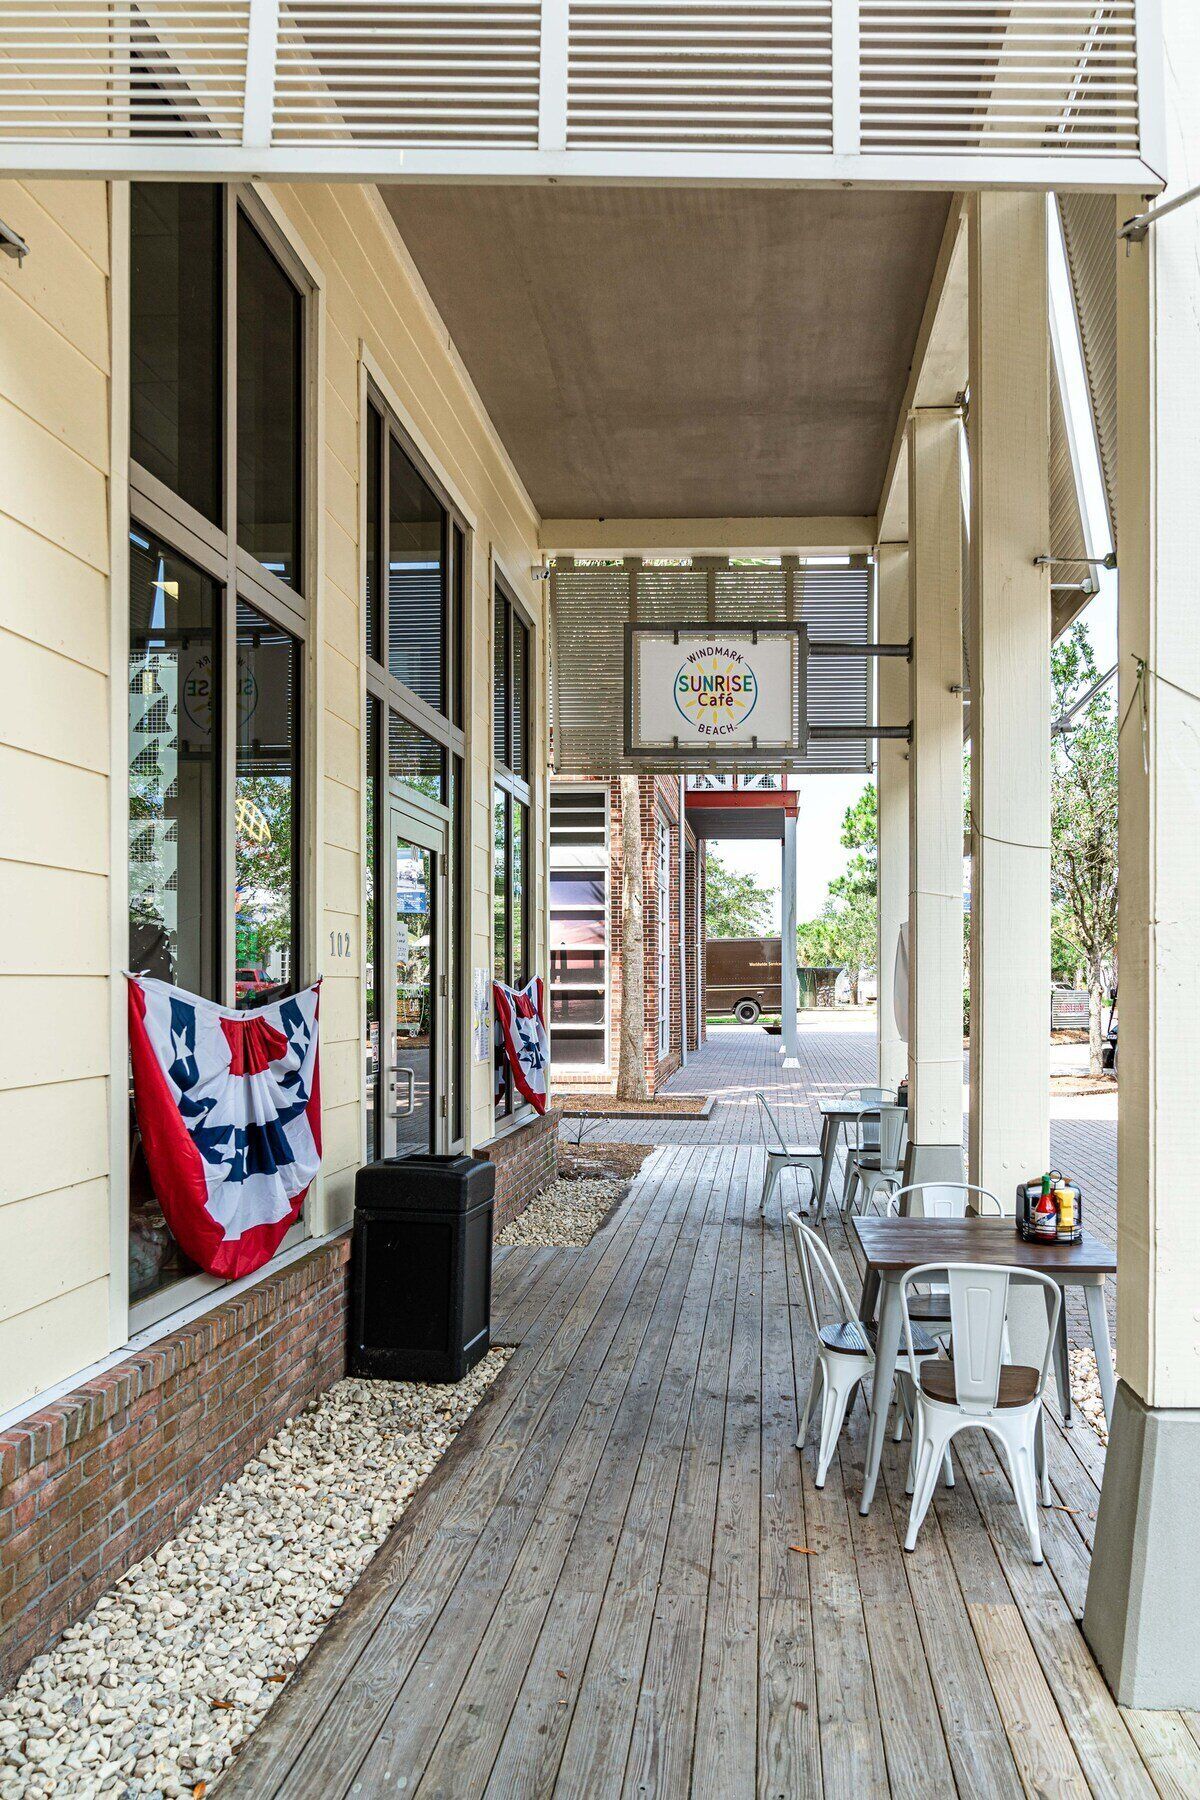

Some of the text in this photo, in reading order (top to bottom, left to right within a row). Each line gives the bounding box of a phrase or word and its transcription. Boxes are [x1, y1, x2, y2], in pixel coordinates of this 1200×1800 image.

[687, 647, 743, 664] WINDMARK
[678, 675, 753, 692] SUNRISE
[698, 692, 734, 706] Café
[698, 723, 734, 735] BEACH
[330, 931, 351, 957] 102
